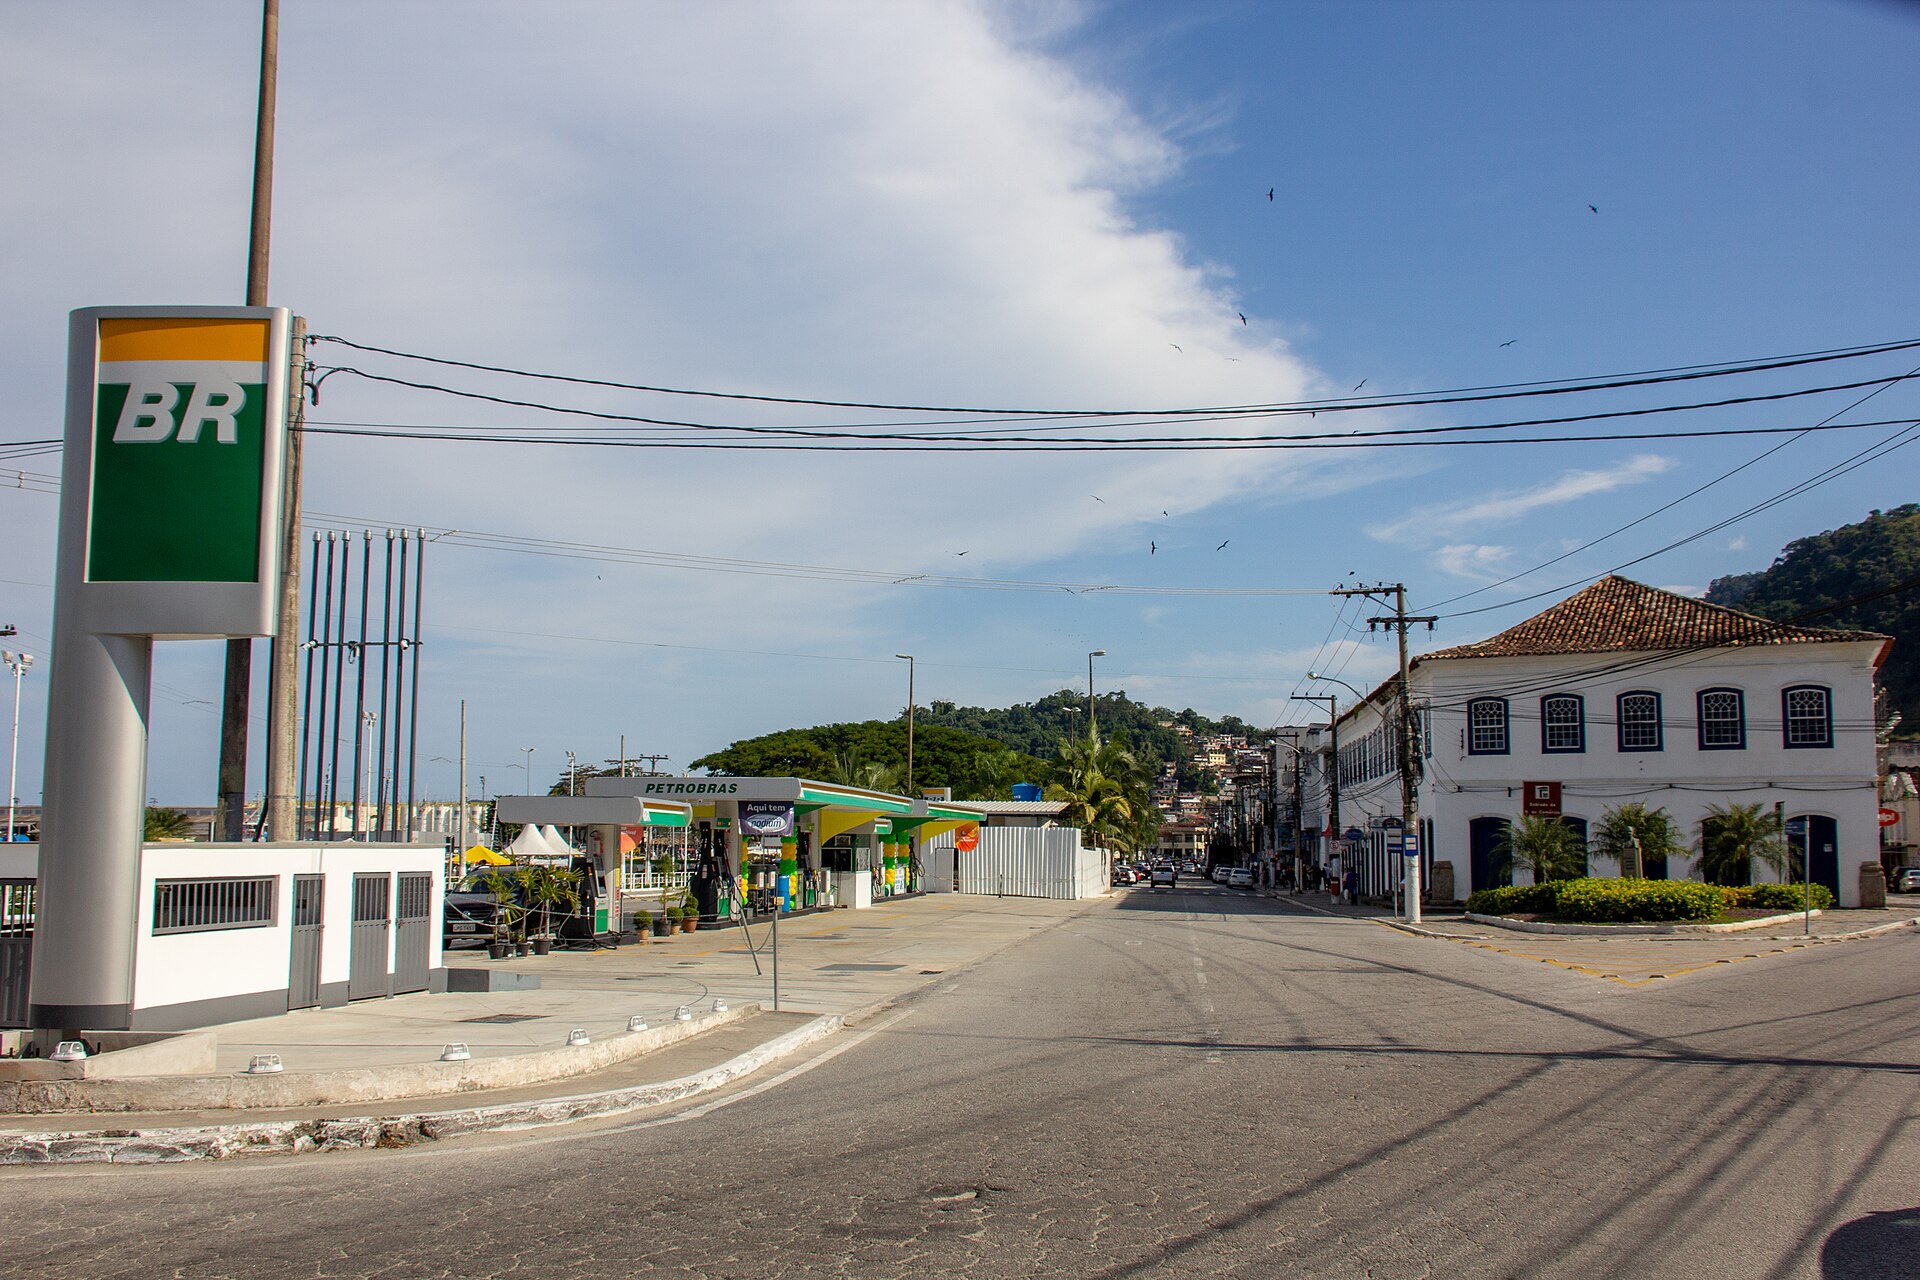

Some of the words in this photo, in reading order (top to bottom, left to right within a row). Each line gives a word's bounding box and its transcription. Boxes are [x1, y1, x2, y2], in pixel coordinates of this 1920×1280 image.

[112, 380, 247, 443] BR
[645, 783, 738, 794] PETROBRAS
[747, 803, 767, 813] Aqui
